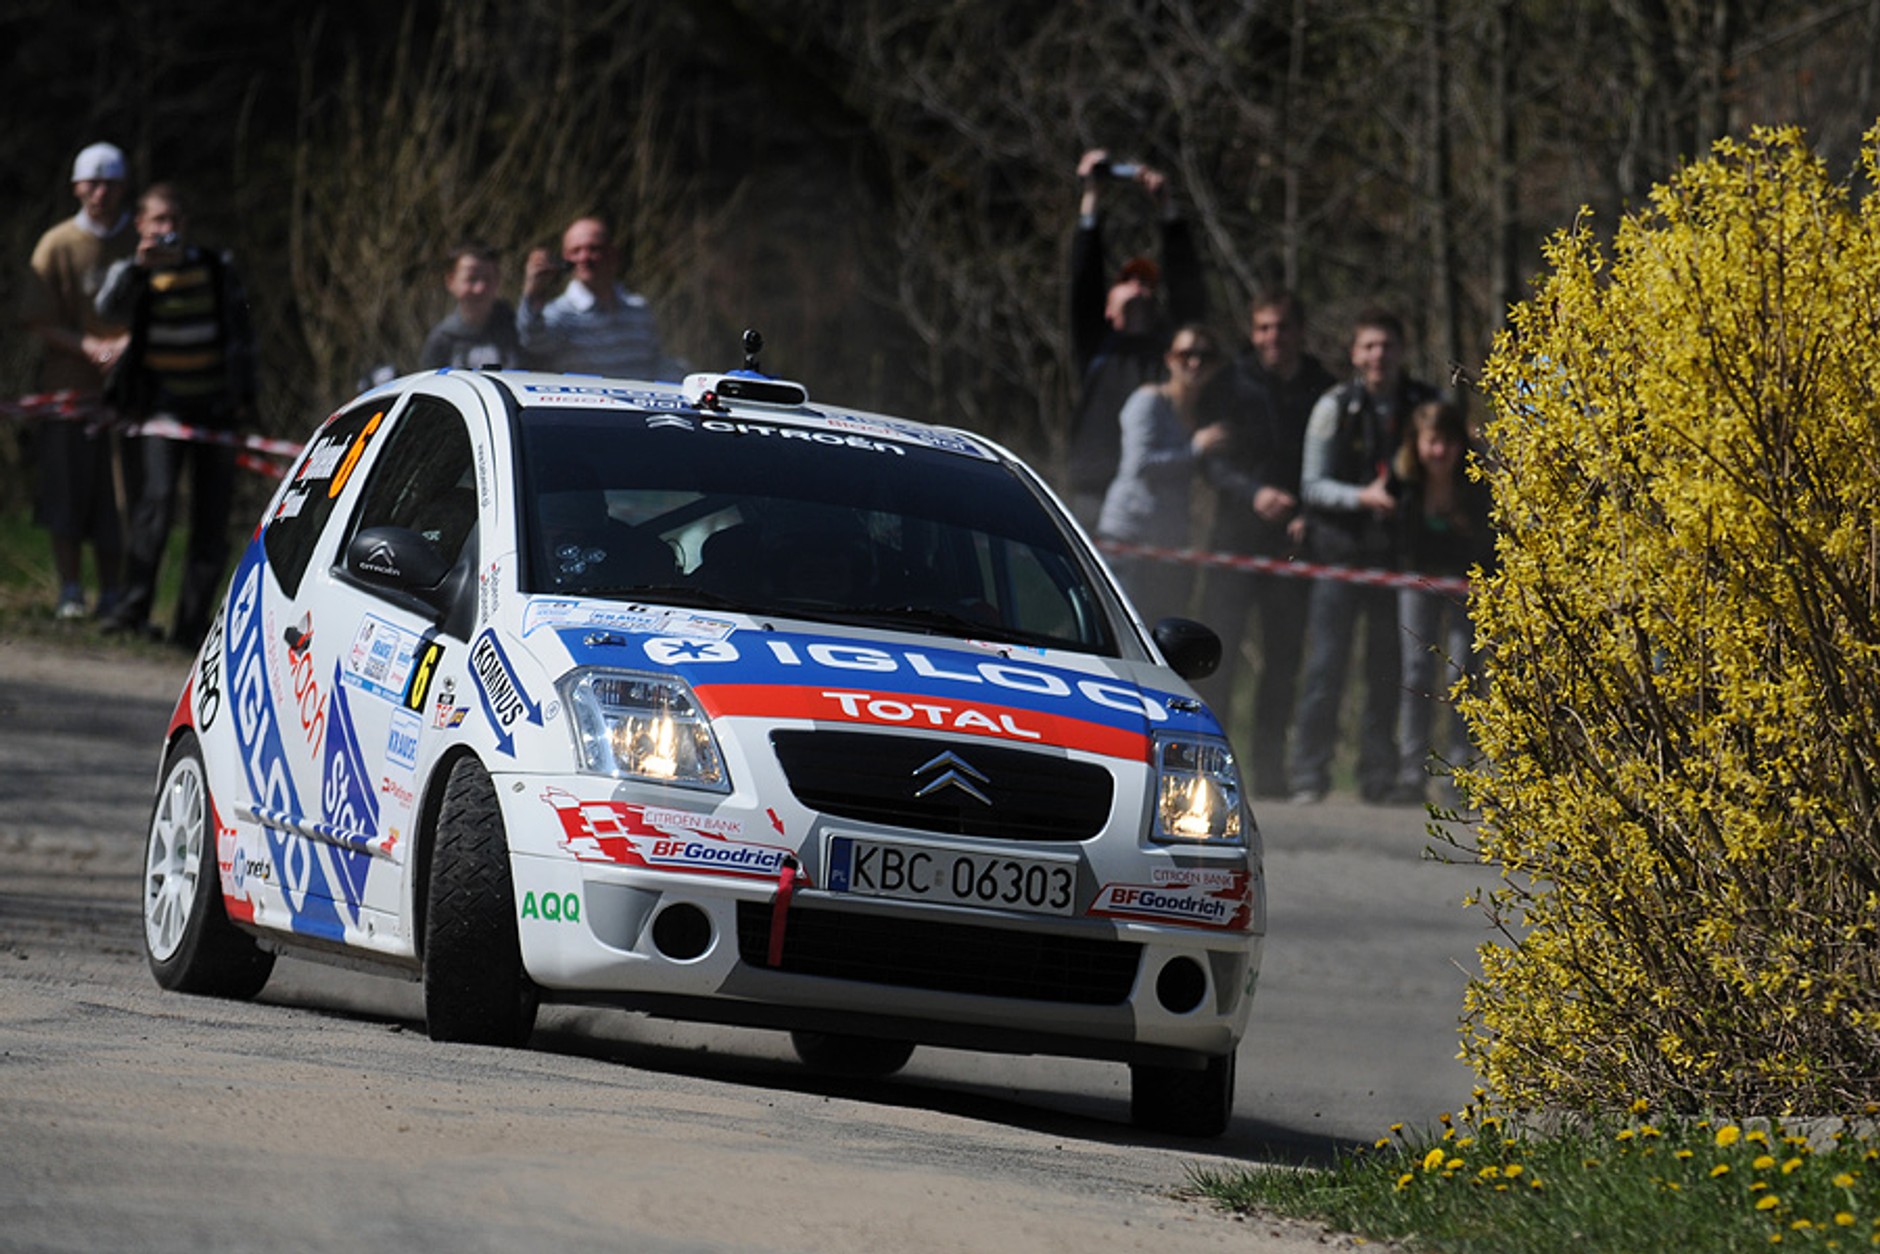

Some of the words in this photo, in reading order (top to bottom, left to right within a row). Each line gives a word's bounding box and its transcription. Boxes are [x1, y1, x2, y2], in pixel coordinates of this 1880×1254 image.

[328, 411, 383, 498] 6
[411, 645, 438, 709] 6
[474, 638, 524, 726] KOMINUS
[766, 641, 1168, 721] IGLOO
[822, 692, 1041, 739] TOTAL
[704, 818, 741, 832] BANK
[521, 891, 580, 923] AQQ
[853, 845, 932, 893] KBC
[952, 857, 1072, 908] 06303
[1111, 888, 1225, 916] BFGoodrich
